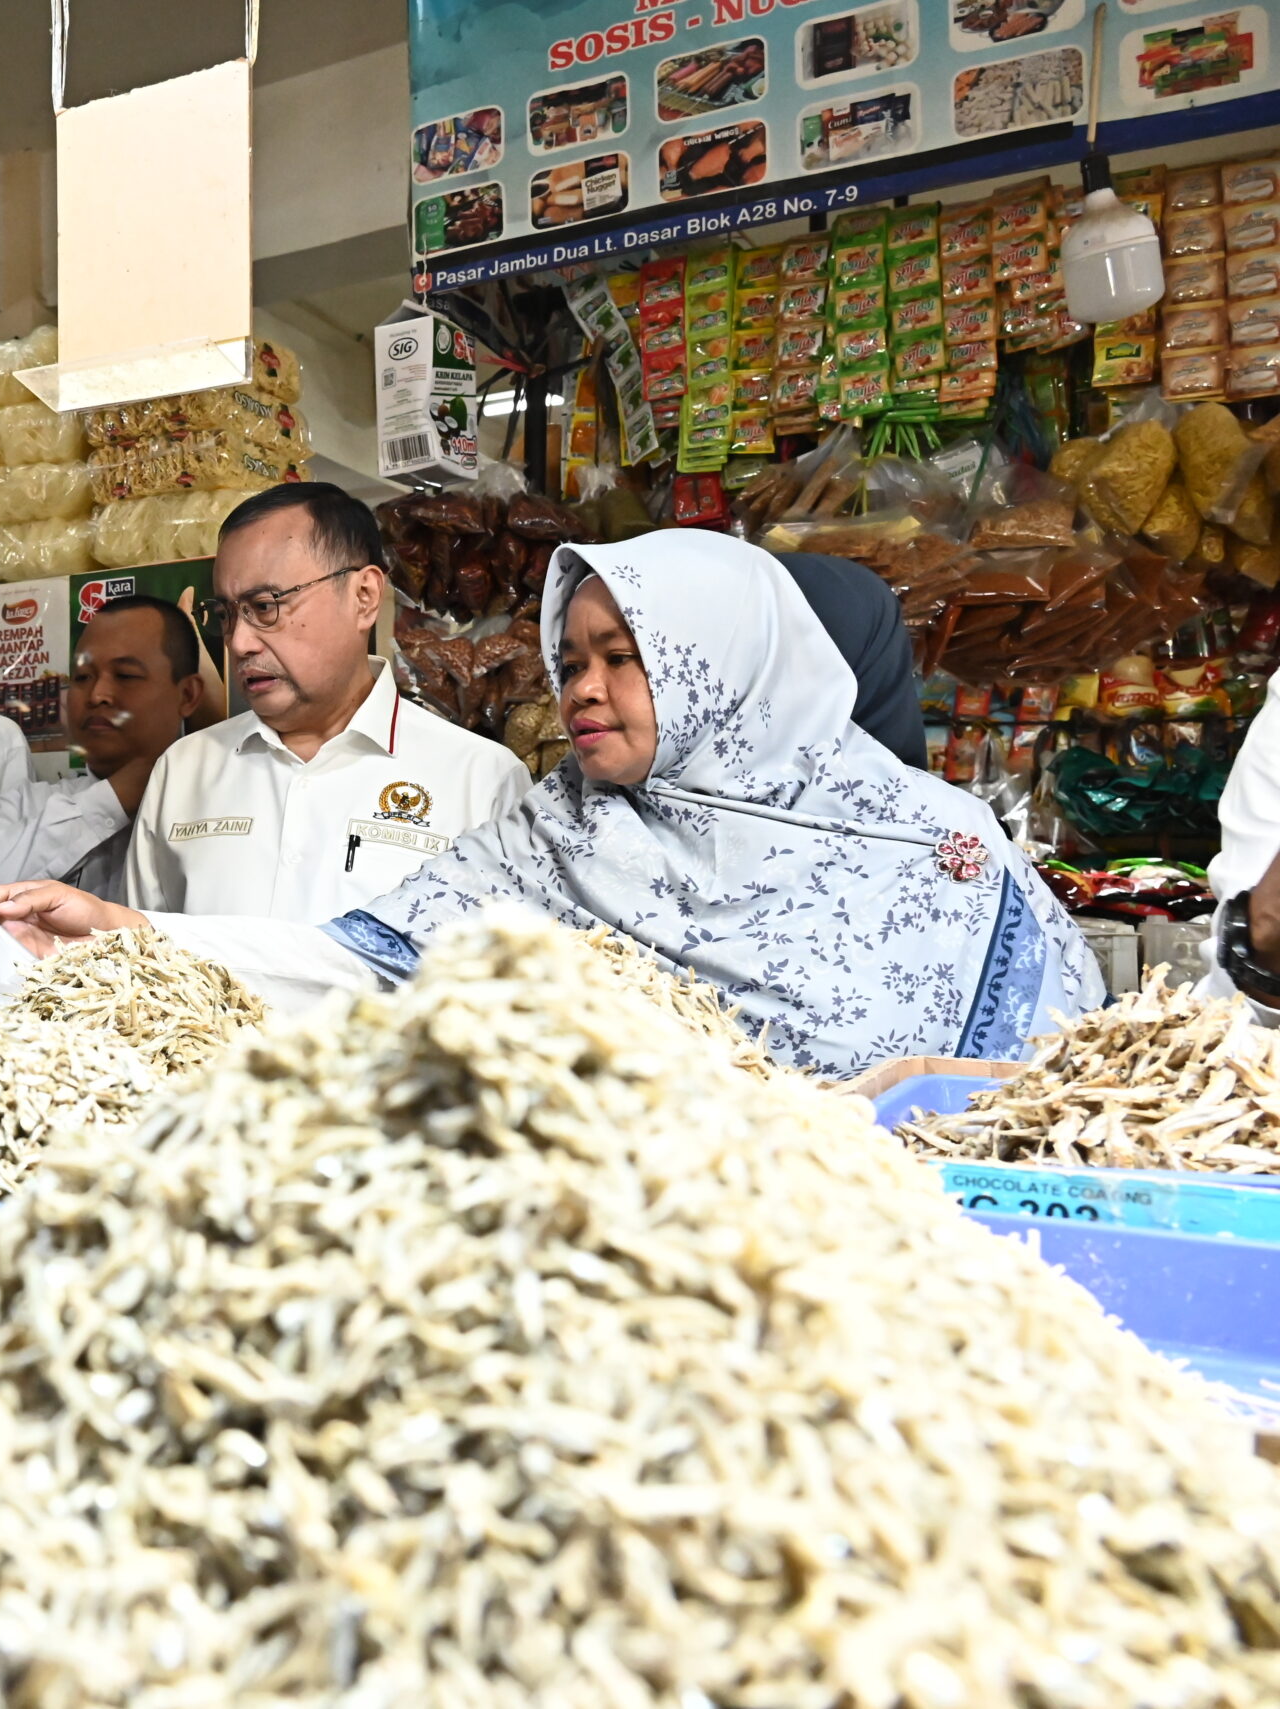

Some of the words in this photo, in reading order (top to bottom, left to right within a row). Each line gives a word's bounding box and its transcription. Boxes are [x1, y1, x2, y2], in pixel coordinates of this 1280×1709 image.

[549, 12, 675, 71] SOSIS
[585, 173, 617, 189] Chicken
[586, 180, 616, 196] Nugget
[436, 264, 484, 287] Pasar
[488, 250, 548, 276] Jambu
[553, 239, 589, 262] Dua
[594, 235, 618, 253] Lt.
[624, 224, 681, 248] Dasar
[687, 213, 731, 235] Blok
[736, 202, 777, 225] A28
[783, 197, 817, 215] No.
[825, 185, 858, 206] 7-9
[392, 340, 412, 357] SIG
[451, 371, 473, 381] KELAPA
[108, 581, 132, 596] kara
[174, 821, 208, 838] YAHYA
[213, 819, 250, 833] ZAINI
[355, 823, 418, 846] KOMISI
[423, 836, 440, 852] IX
[952, 1174, 1061, 1198] CHOCOLATE
